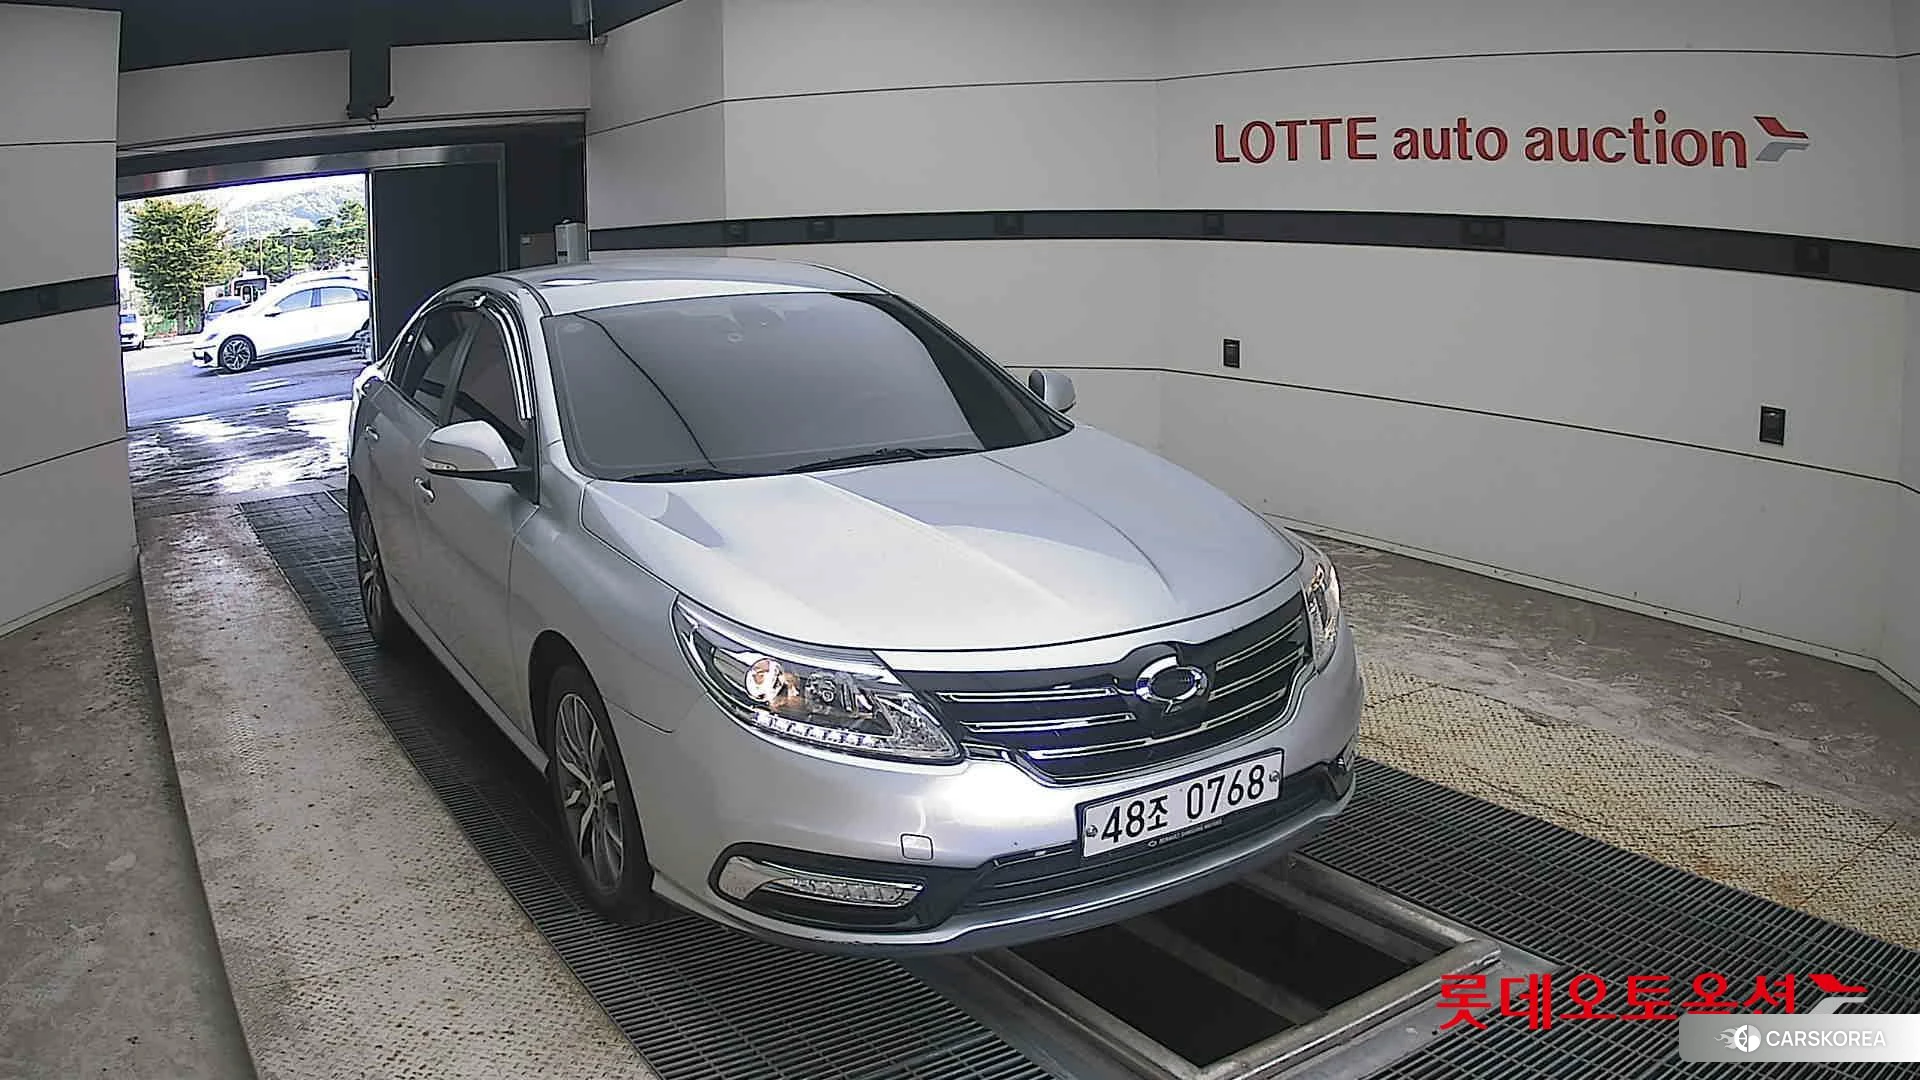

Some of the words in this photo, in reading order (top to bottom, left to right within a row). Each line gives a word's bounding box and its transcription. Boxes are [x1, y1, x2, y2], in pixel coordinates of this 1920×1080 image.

[1216, 116, 1377, 163] LOTTE
[1393, 117, 1508, 160] auto
[1524, 111, 1747, 168] auction
[1101, 795, 1168, 843] 48조
[1187, 764, 1264, 820] 0768
